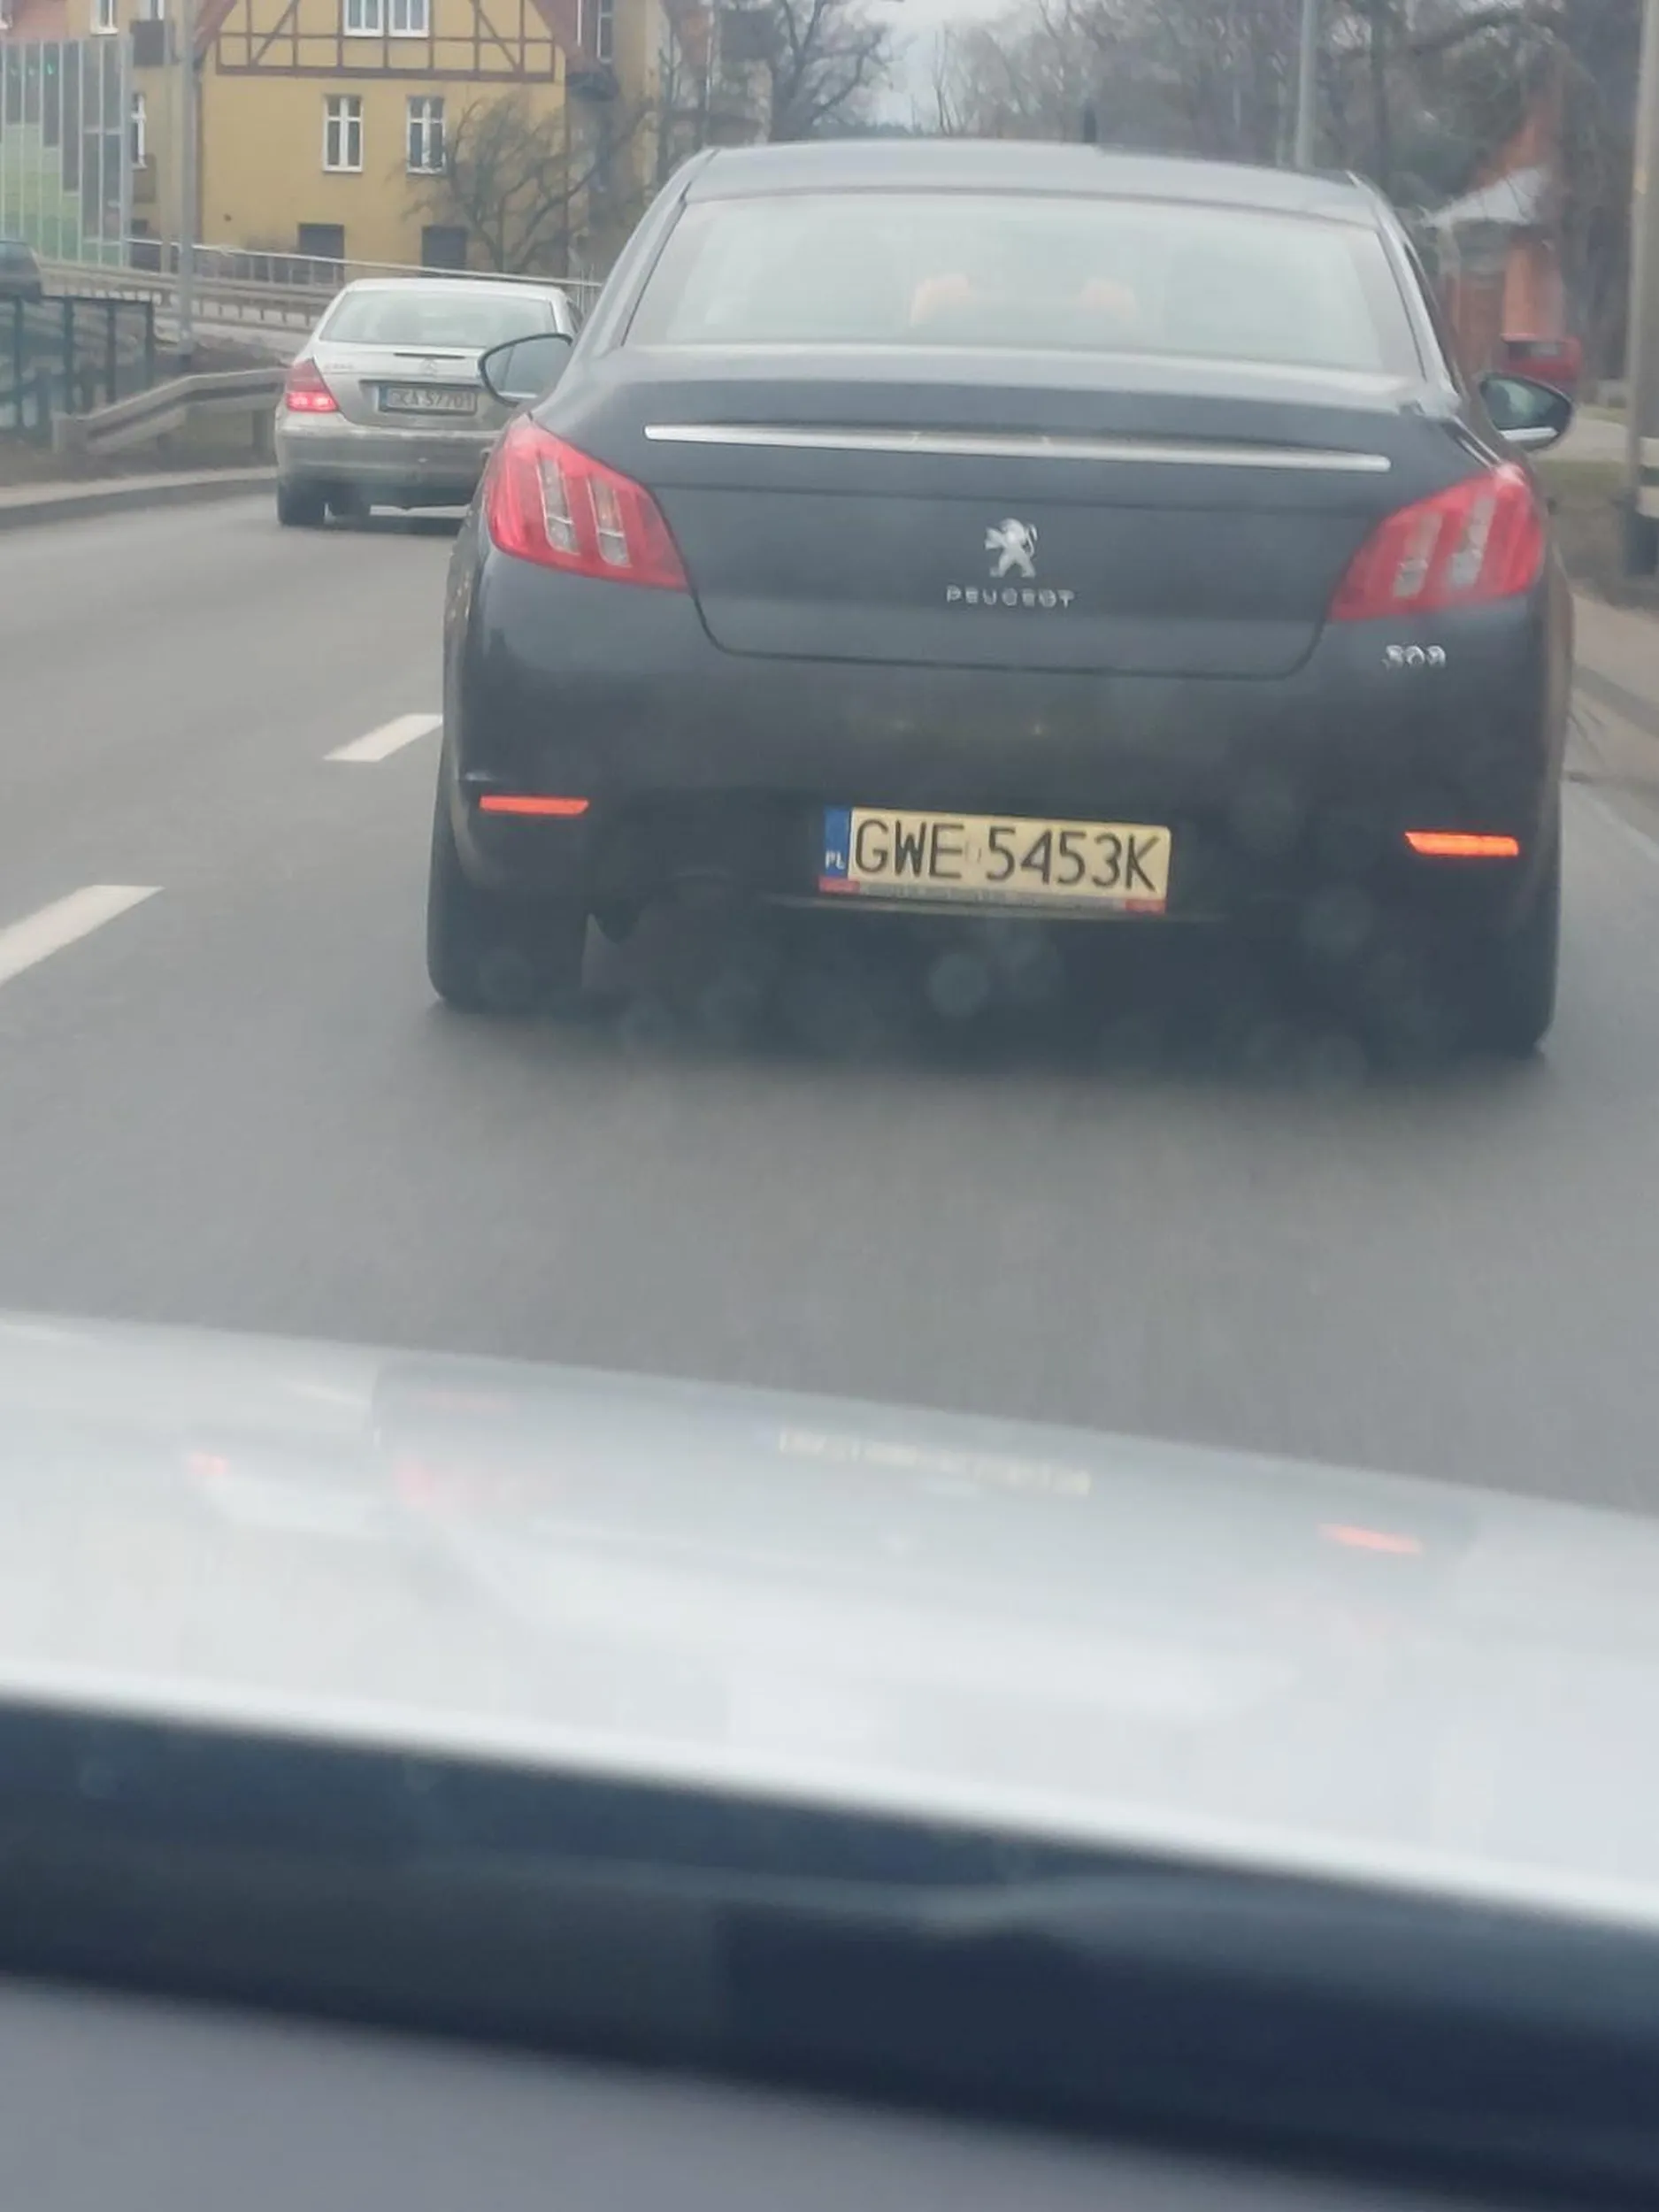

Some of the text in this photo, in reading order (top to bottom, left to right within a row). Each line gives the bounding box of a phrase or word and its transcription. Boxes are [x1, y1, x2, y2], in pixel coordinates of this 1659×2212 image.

[946, 584, 1075, 609] PEUGEOT
[825, 849, 845, 870] PL
[855, 818, 1160, 892] GWE 5453K
